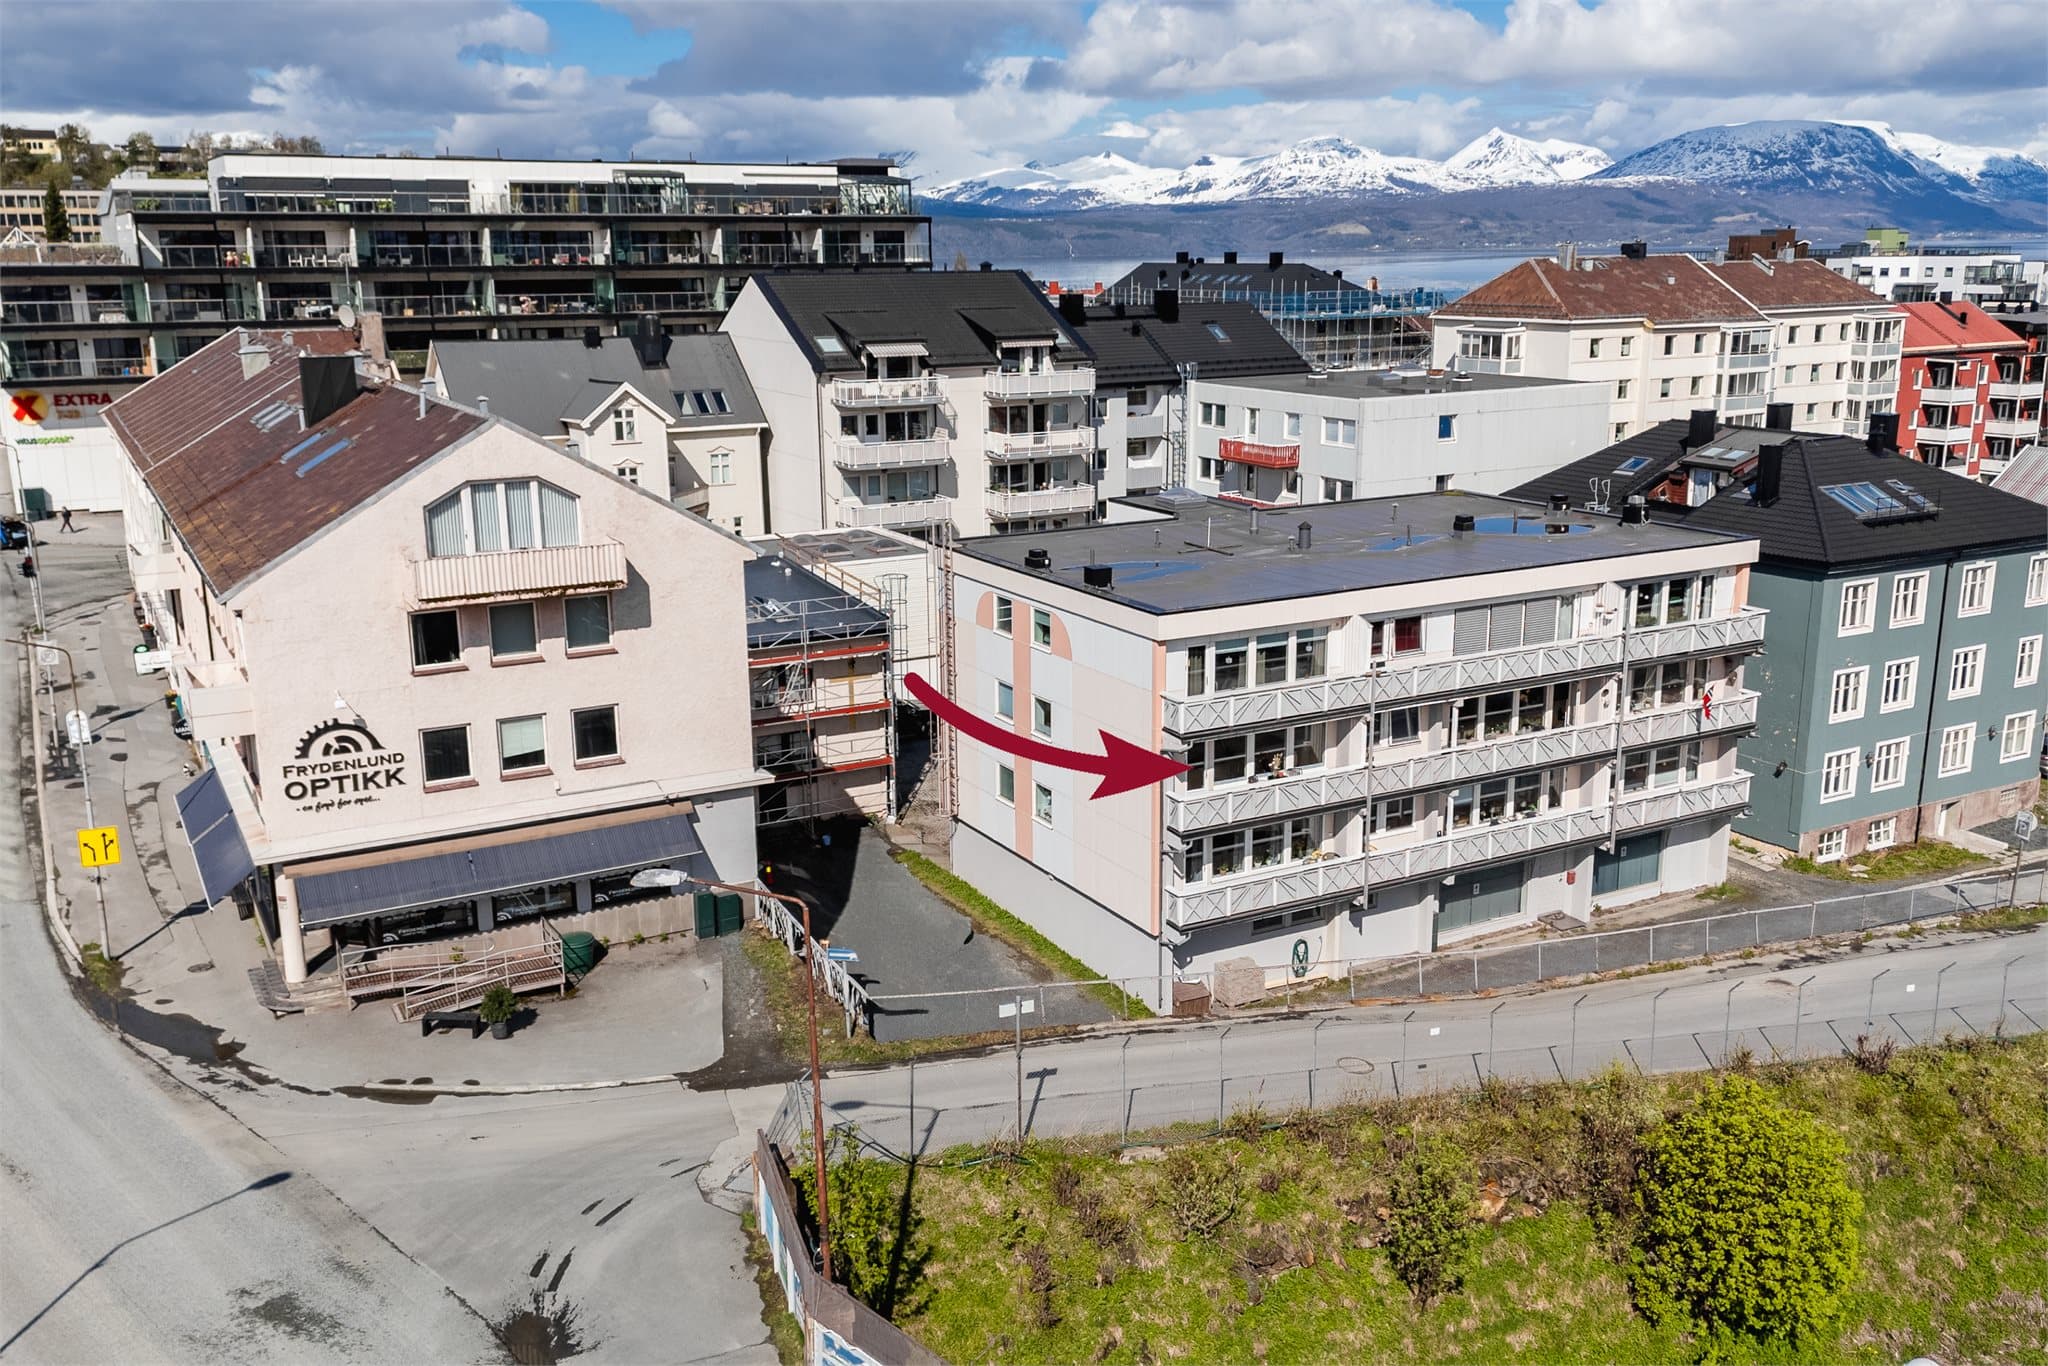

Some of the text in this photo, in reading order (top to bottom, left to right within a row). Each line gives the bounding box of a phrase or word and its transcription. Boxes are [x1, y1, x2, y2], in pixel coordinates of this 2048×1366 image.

[54, 393, 112, 406] EXTRA
[282, 753, 405, 779] FRYDENLUND
[284, 767, 406, 801] OPTIKK
